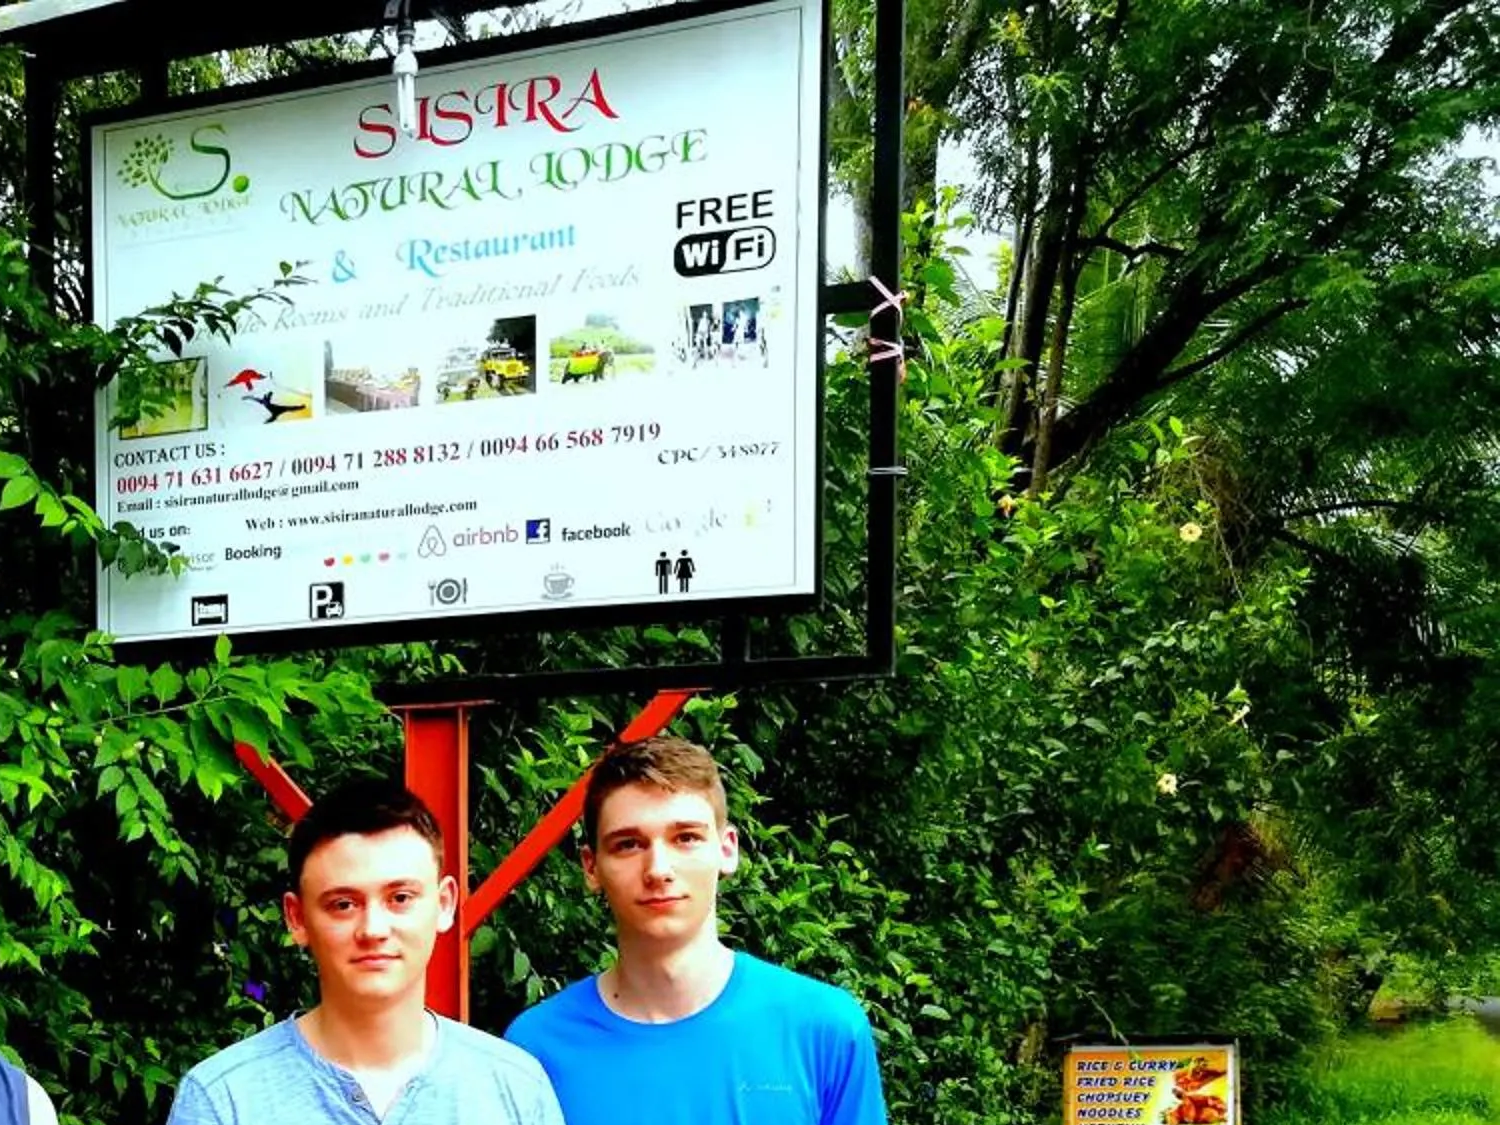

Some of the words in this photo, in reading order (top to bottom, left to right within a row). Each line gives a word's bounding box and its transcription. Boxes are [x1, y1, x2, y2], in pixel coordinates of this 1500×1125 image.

[353, 67, 620, 159] SISIRA
[279, 160, 523, 226] NATURAL
[530, 128, 709, 191] LODGE
[676, 189, 774, 230] FREE
[331, 248, 357, 284] &
[395, 222, 577, 279] Restaurant
[359, 292, 409, 320] and
[421, 279, 559, 312] Traditional
[114, 445, 191, 468] CONTACT
[195, 442, 217, 459] US
[116, 473, 159, 495] 0094
[166, 471, 184, 489] 71
[191, 467, 222, 486] 631
[229, 461, 274, 482] 6627
[291, 455, 336, 476] 0094
[344, 452, 364, 471] 71
[373, 447, 407, 469] 288
[413, 441, 461, 464] 8132
[480, 435, 529, 457] 0094
[535, 431, 560, 452] 66
[566, 428, 604, 448] 568
[610, 422, 661, 443] 7919
[116, 498, 153, 513] Email
[245, 517, 275, 531] Web
[287, 498, 478, 527] www.sisiranaturallodge.com
[149, 526, 165, 538] us
[452, 524, 519, 547] airbnb
[560, 523, 632, 542] facebook
[225, 544, 283, 561] Booking
[1076, 1061, 1110, 1071] RICE
[1128, 1060, 1177, 1071] CURRY
[1076, 1077, 1118, 1087] FRIED
[1123, 1076, 1156, 1087] RICE
[1076, 1092, 1151, 1103] CHOPSUEY
[1076, 1108, 1144, 1118] NOODLES
